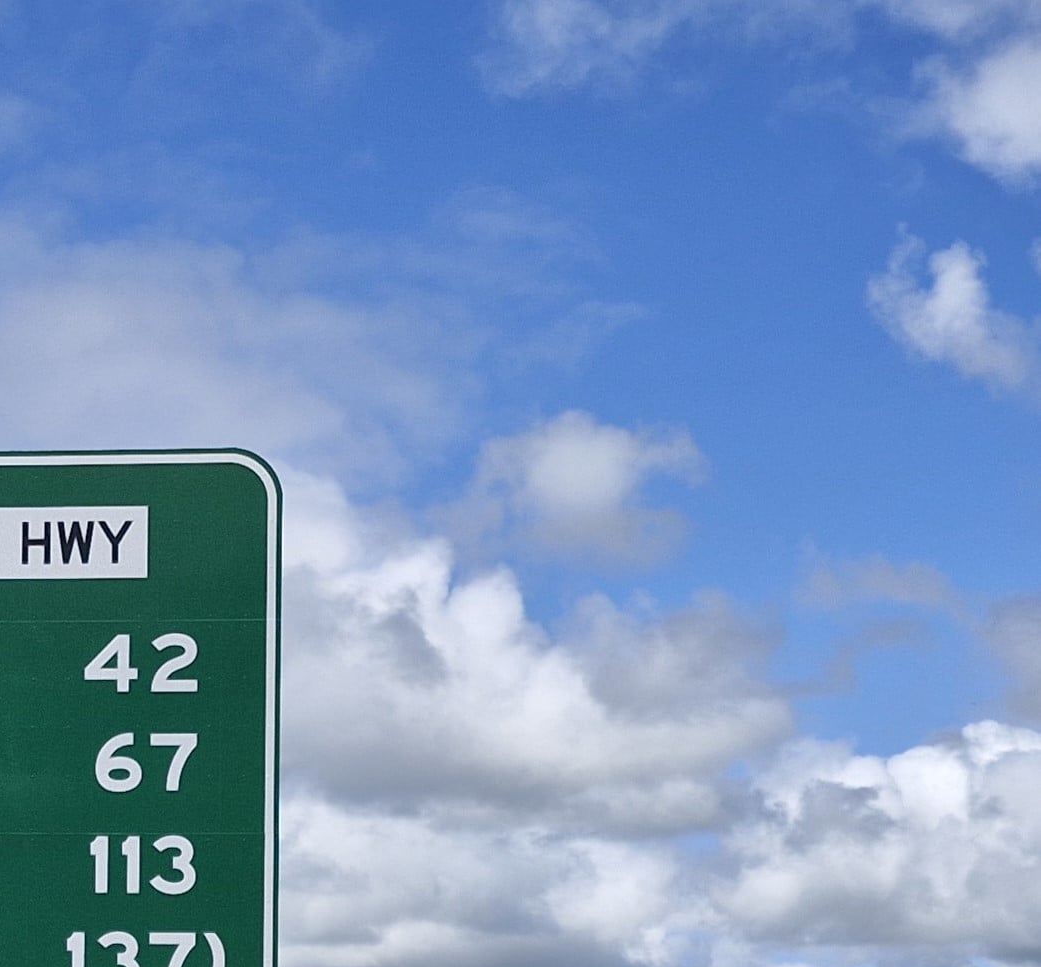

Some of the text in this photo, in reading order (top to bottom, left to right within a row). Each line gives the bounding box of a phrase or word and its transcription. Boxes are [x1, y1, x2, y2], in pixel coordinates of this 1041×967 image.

[22, 521, 132, 564] HWY
[85, 633, 197, 692] 42
[96, 733, 197, 792] 67
[90, 835, 195, 894] 113
